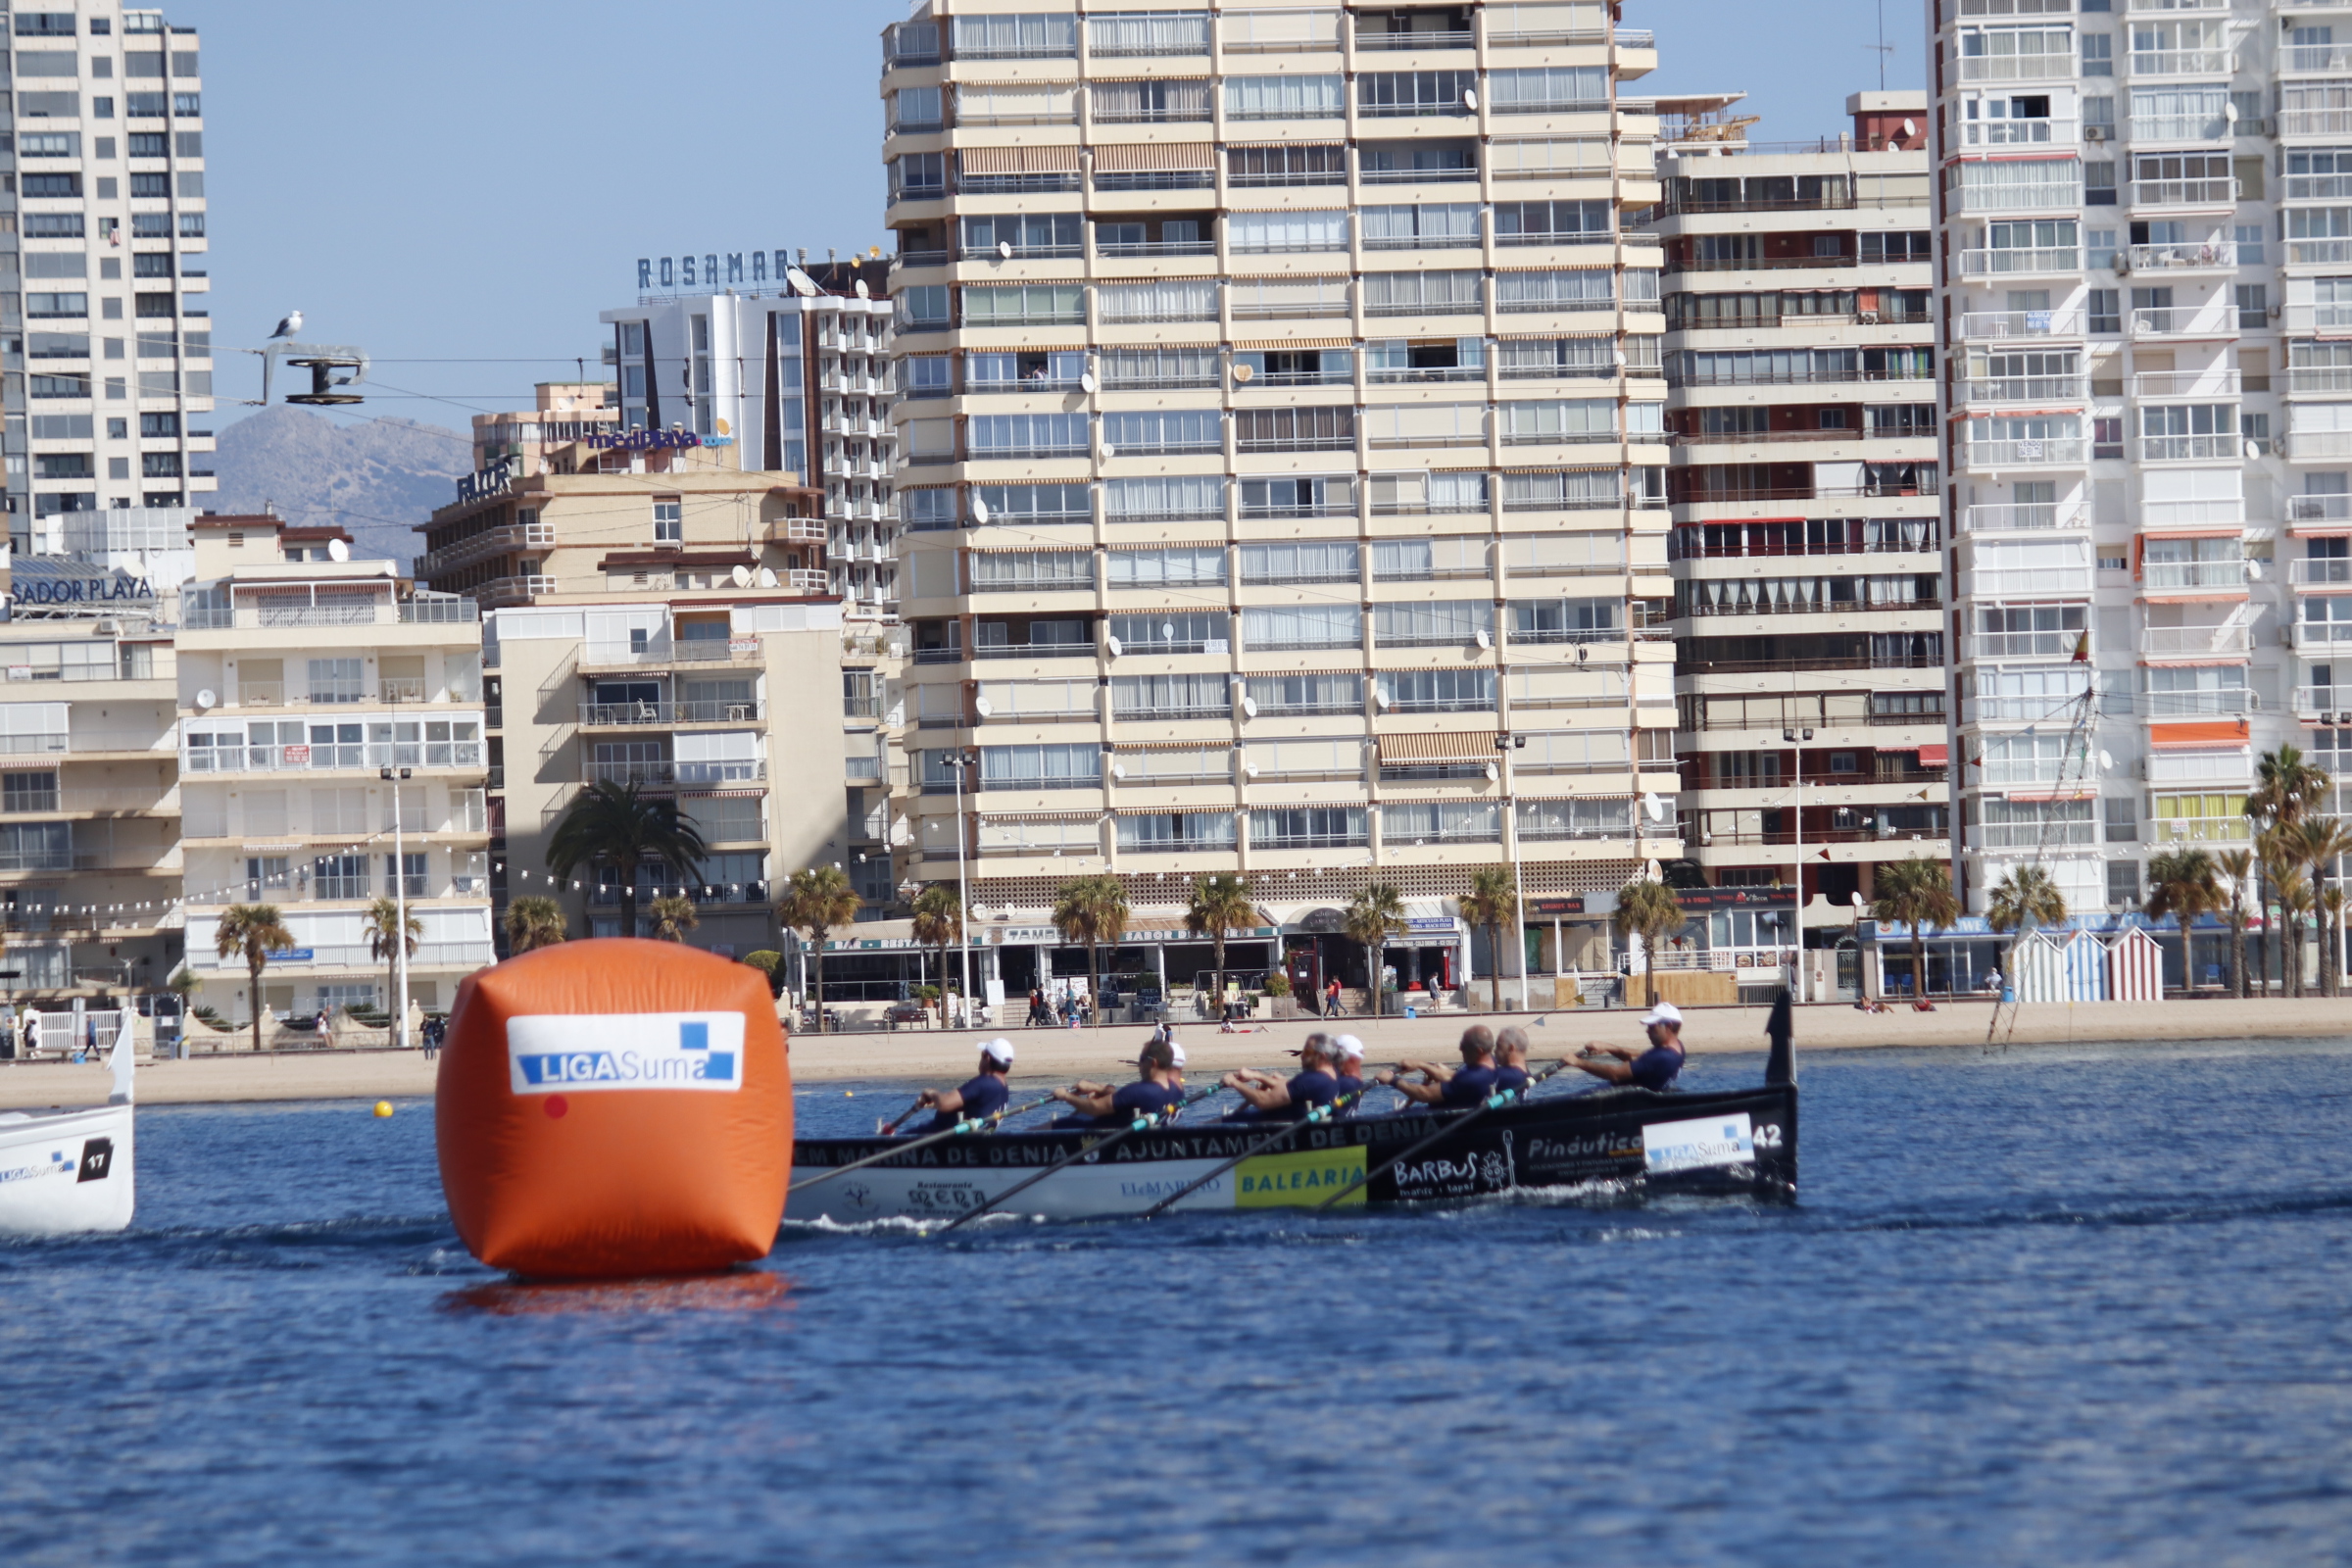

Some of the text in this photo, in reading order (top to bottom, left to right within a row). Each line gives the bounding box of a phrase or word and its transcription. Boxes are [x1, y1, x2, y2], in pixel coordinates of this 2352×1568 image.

[637, 249, 789, 288] ROSAMAR
[89, 576, 153, 601] PLAYA
[2080, 916, 2097, 928] LA
[835, 941, 861, 950] BAR
[1126, 931, 1172, 941] SABOR
[541, 1051, 710, 1082] LIGASuma
[1116, 1117, 1442, 1160] AJUNTAMENT DE DENIA
[1753, 1124, 1783, 1148] 42
[87, 1152, 105, 1171] 17
[948, 1147, 978, 1164] DE
[990, 1144, 1068, 1164] DENIA
[1, 1162, 65, 1182] LIGASuma
[1395, 1152, 1477, 1186] BARBUS
